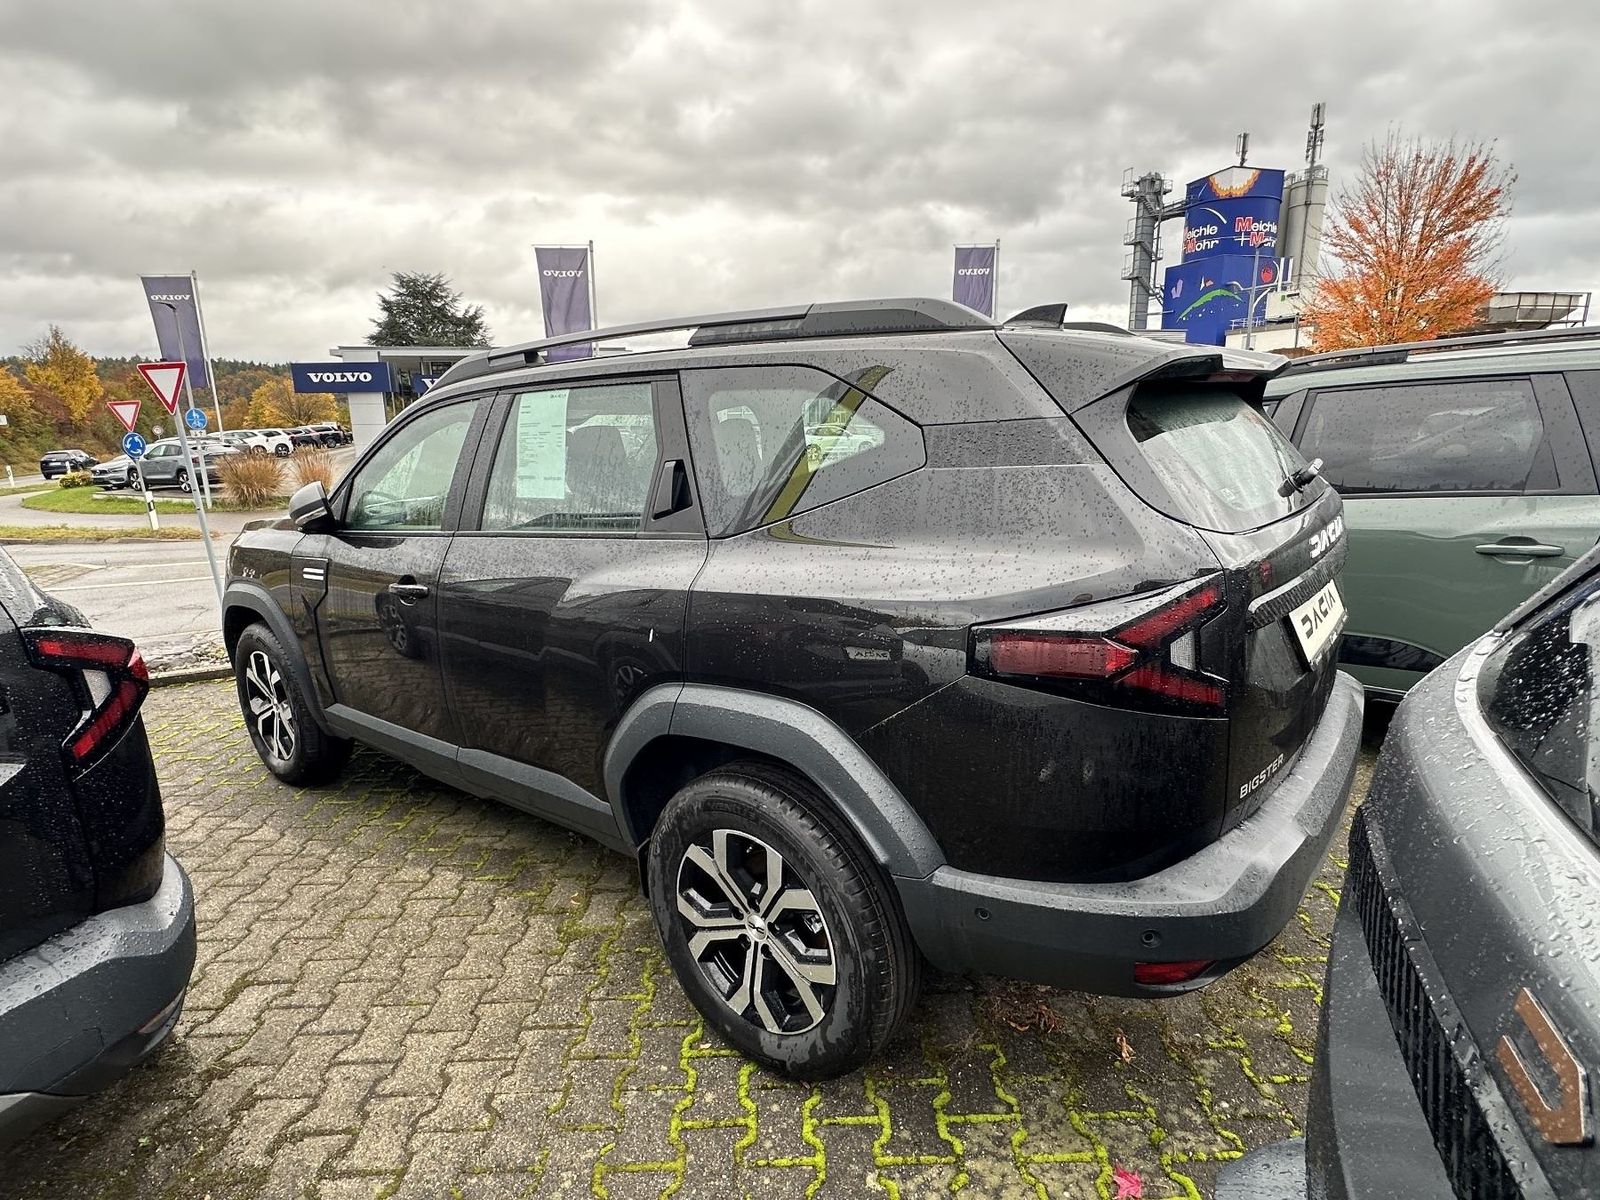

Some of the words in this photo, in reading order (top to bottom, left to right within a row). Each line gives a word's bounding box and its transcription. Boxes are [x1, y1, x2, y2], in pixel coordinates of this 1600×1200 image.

[307, 372, 372, 383] VOLVO
[1301, 588, 1336, 640] DACIA
[1239, 753, 1284, 799] BIGSTER
